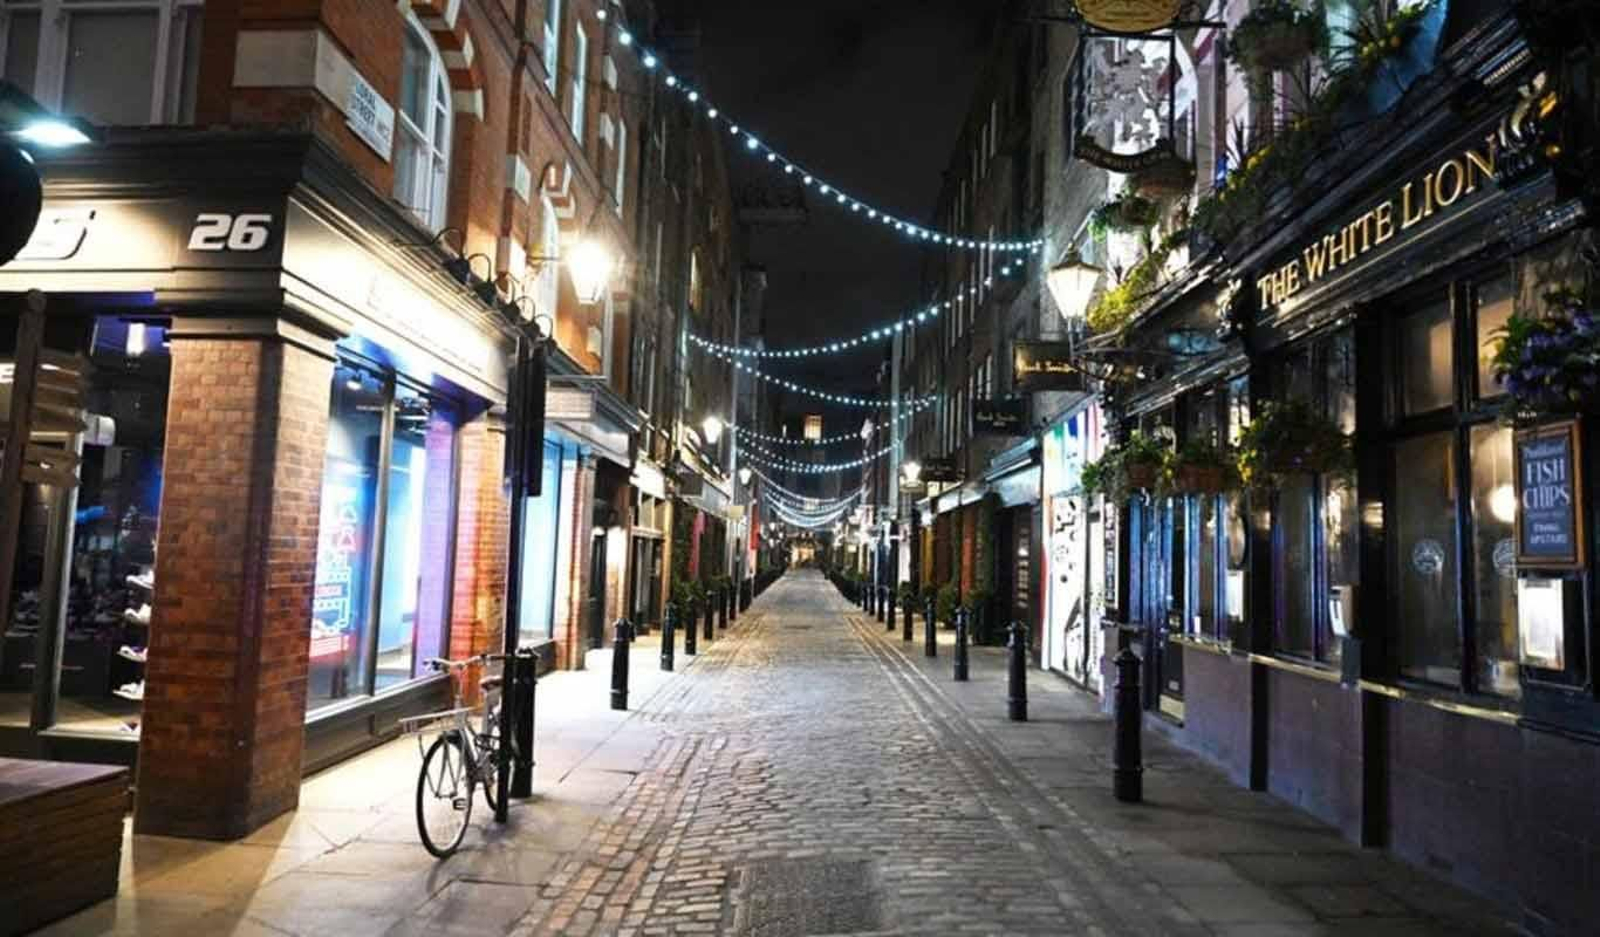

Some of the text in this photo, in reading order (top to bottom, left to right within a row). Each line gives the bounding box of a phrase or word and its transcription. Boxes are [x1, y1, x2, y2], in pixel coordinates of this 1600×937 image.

[187, 213, 273, 251] 26
[1257, 133, 1497, 310] THE WHITE LION
[1526, 459, 1566, 484] FISH
[1523, 485, 1570, 509] CHIPS
